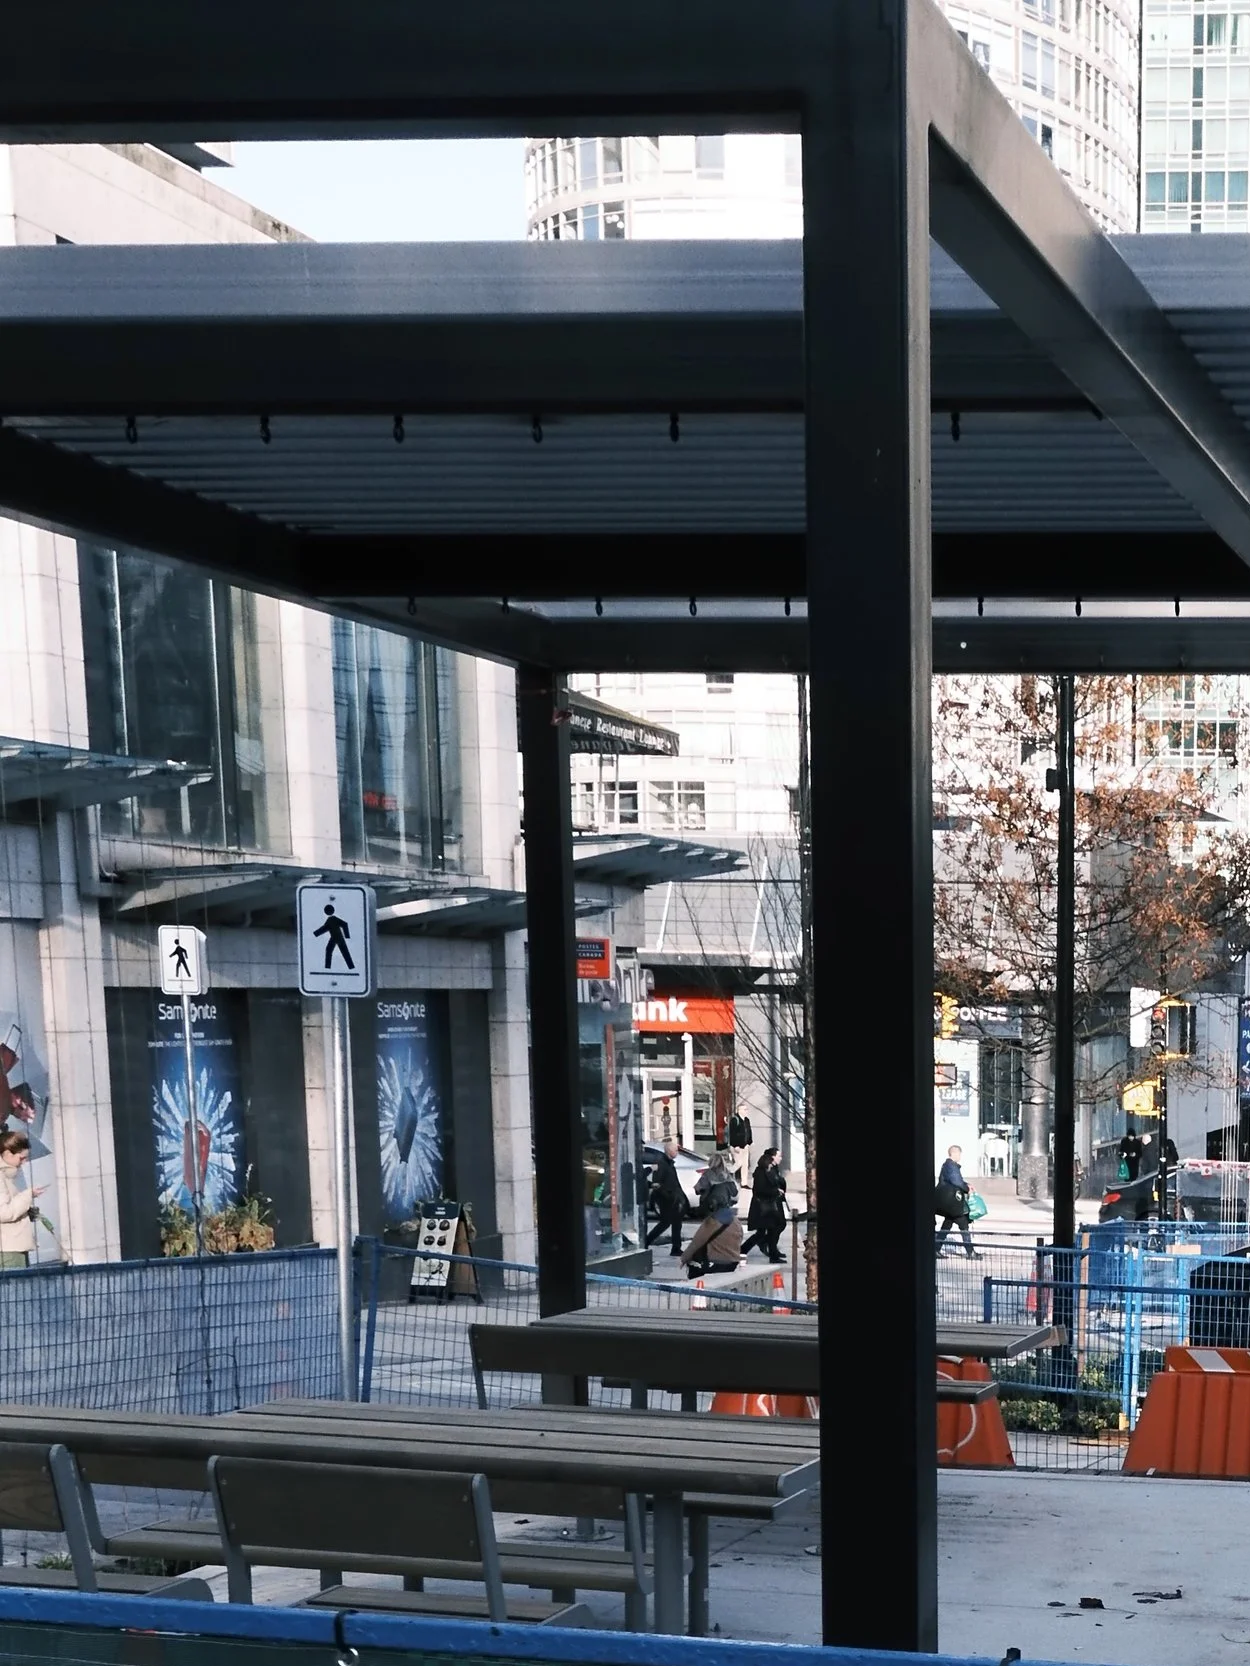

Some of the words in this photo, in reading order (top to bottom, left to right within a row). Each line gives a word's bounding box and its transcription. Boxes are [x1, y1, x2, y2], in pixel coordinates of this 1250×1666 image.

[596, 716, 635, 742] Restaurant
[158, 1003, 217, 1022] Samonite
[377, 1001, 426, 1020] Samsonite
